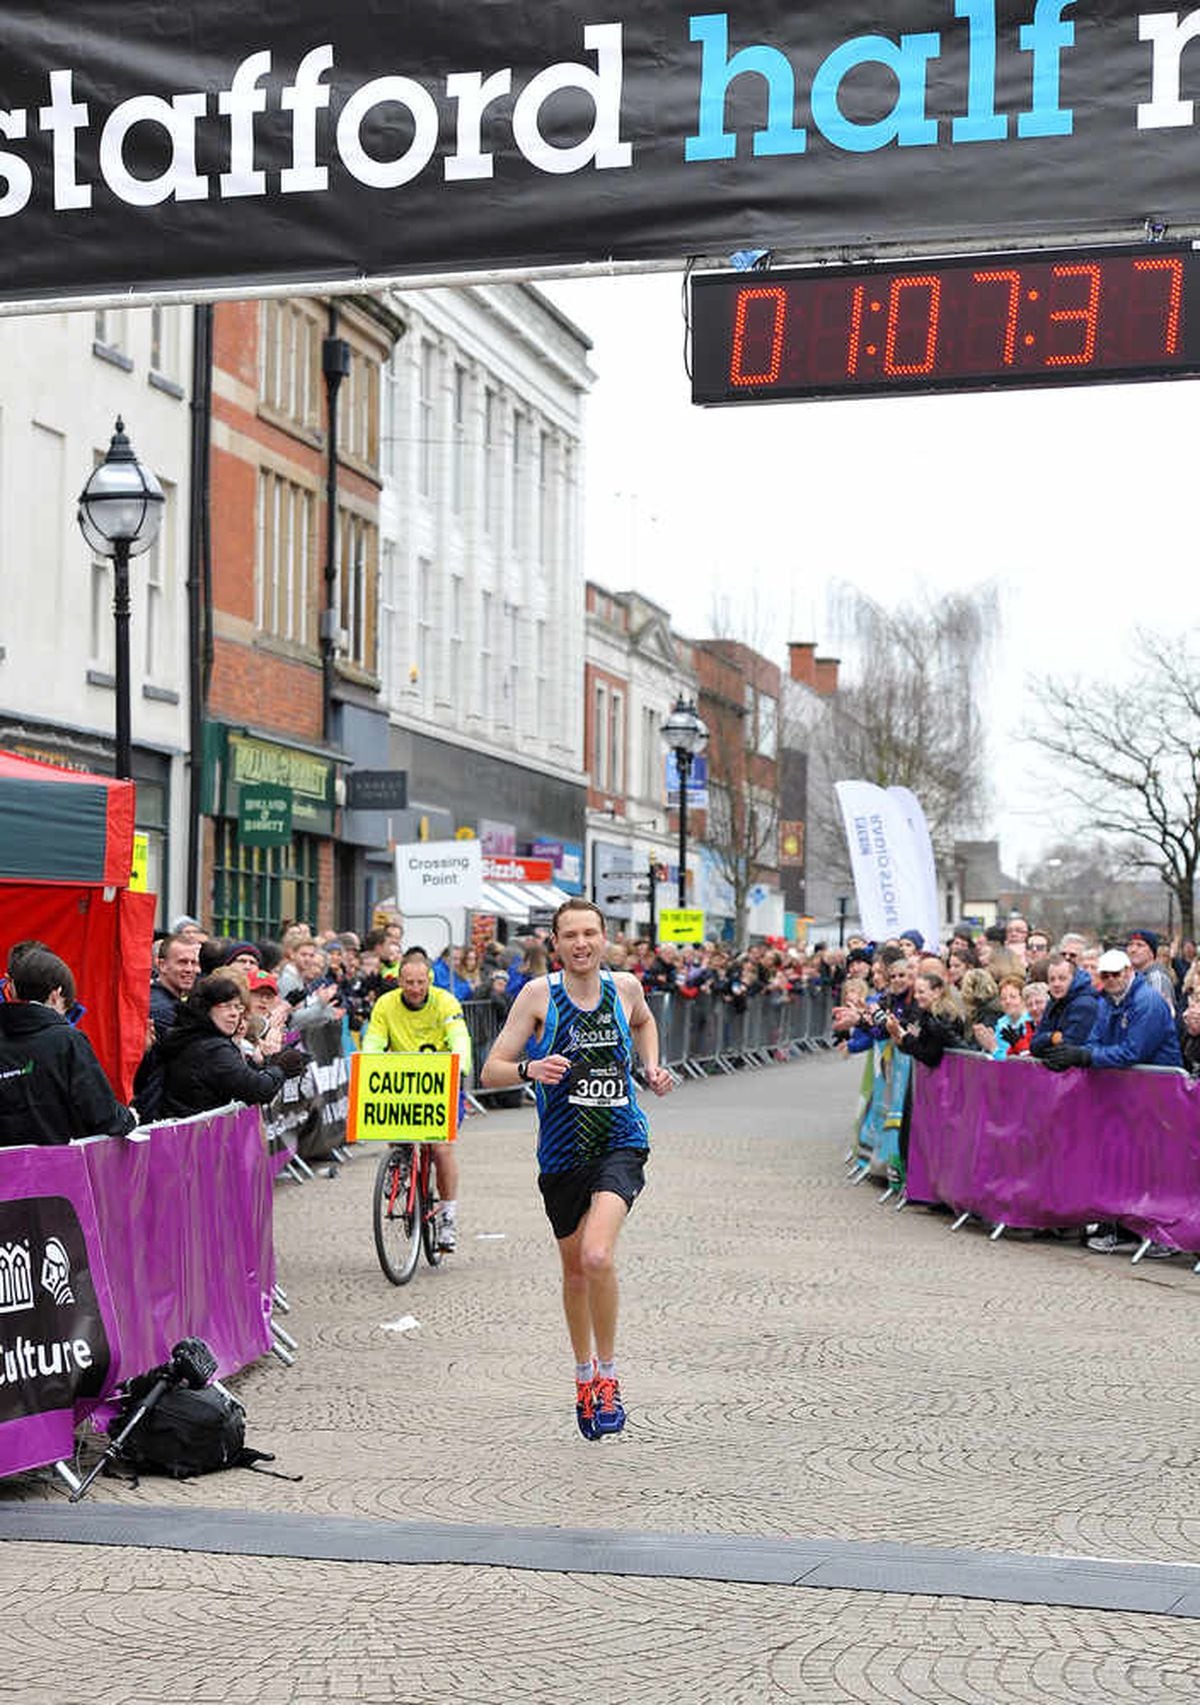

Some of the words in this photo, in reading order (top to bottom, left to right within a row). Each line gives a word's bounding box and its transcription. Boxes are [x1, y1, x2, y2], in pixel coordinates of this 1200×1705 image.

[684, 0, 1077, 162] half
[409, 856, 469, 870] Crossing
[422, 873, 457, 885] Point
[369, 1072, 445, 1094] CAUTION
[576, 1079, 624, 1097] 3001
[364, 1103, 446, 1126] RUNNERS
[0, 1336, 93, 1384] ulture
